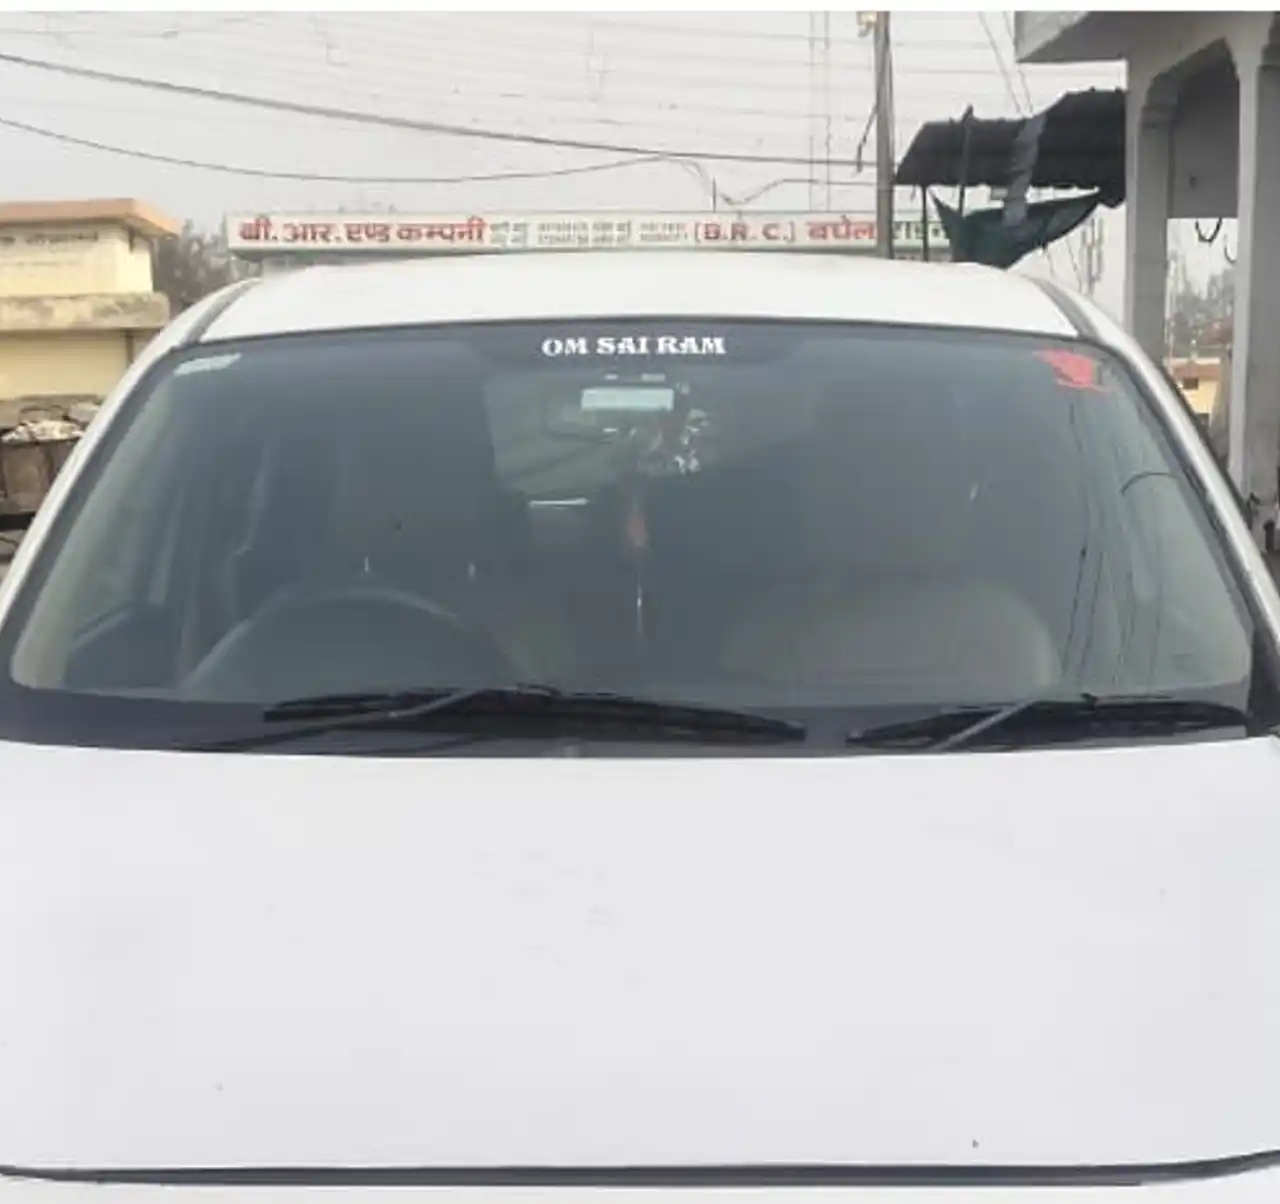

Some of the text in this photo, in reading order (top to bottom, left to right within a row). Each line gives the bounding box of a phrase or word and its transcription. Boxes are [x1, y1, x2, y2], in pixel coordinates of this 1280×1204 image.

[541, 335, 726, 357] OM SAI RAM
